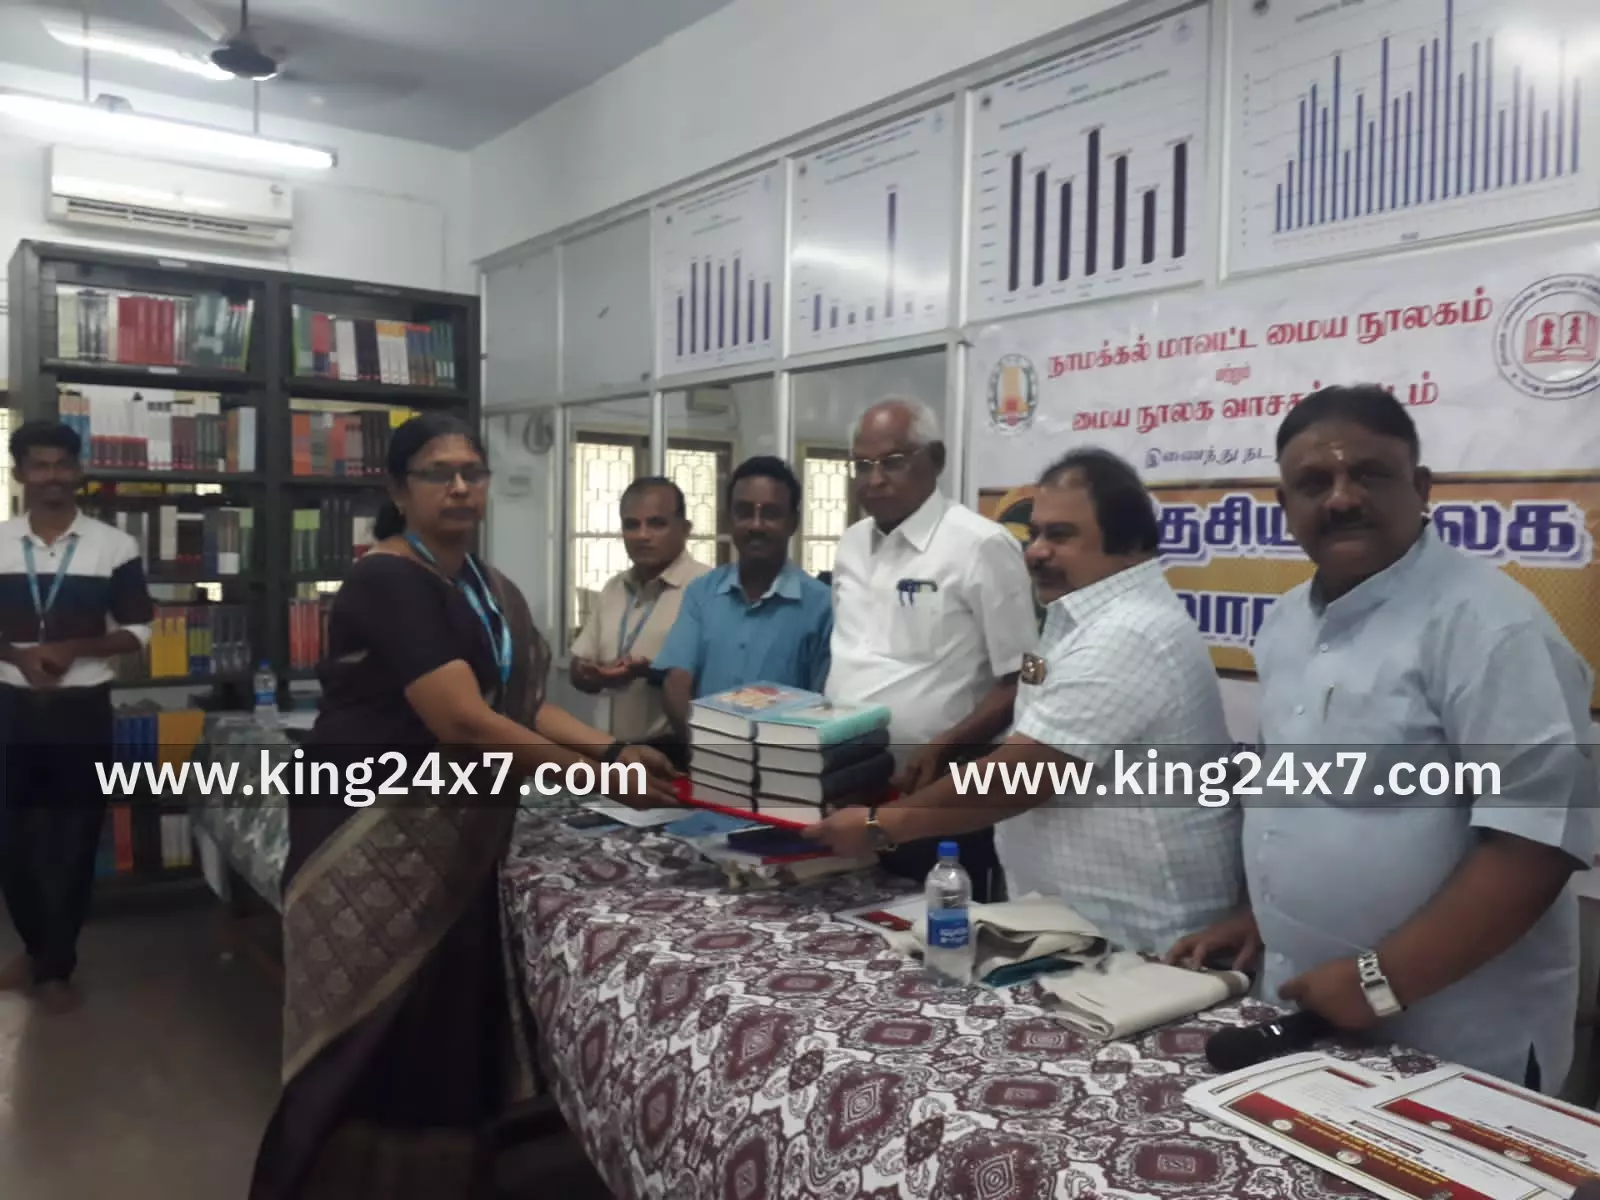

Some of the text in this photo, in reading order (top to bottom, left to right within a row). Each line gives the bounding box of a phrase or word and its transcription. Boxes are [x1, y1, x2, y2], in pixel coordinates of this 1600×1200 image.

[1047, 285, 1494, 379] நாமக்கல் மாவட்ட மைய நூலகம்
[1071, 408, 1130, 432] மைய
[1136, 399, 1215, 435] நூலக
